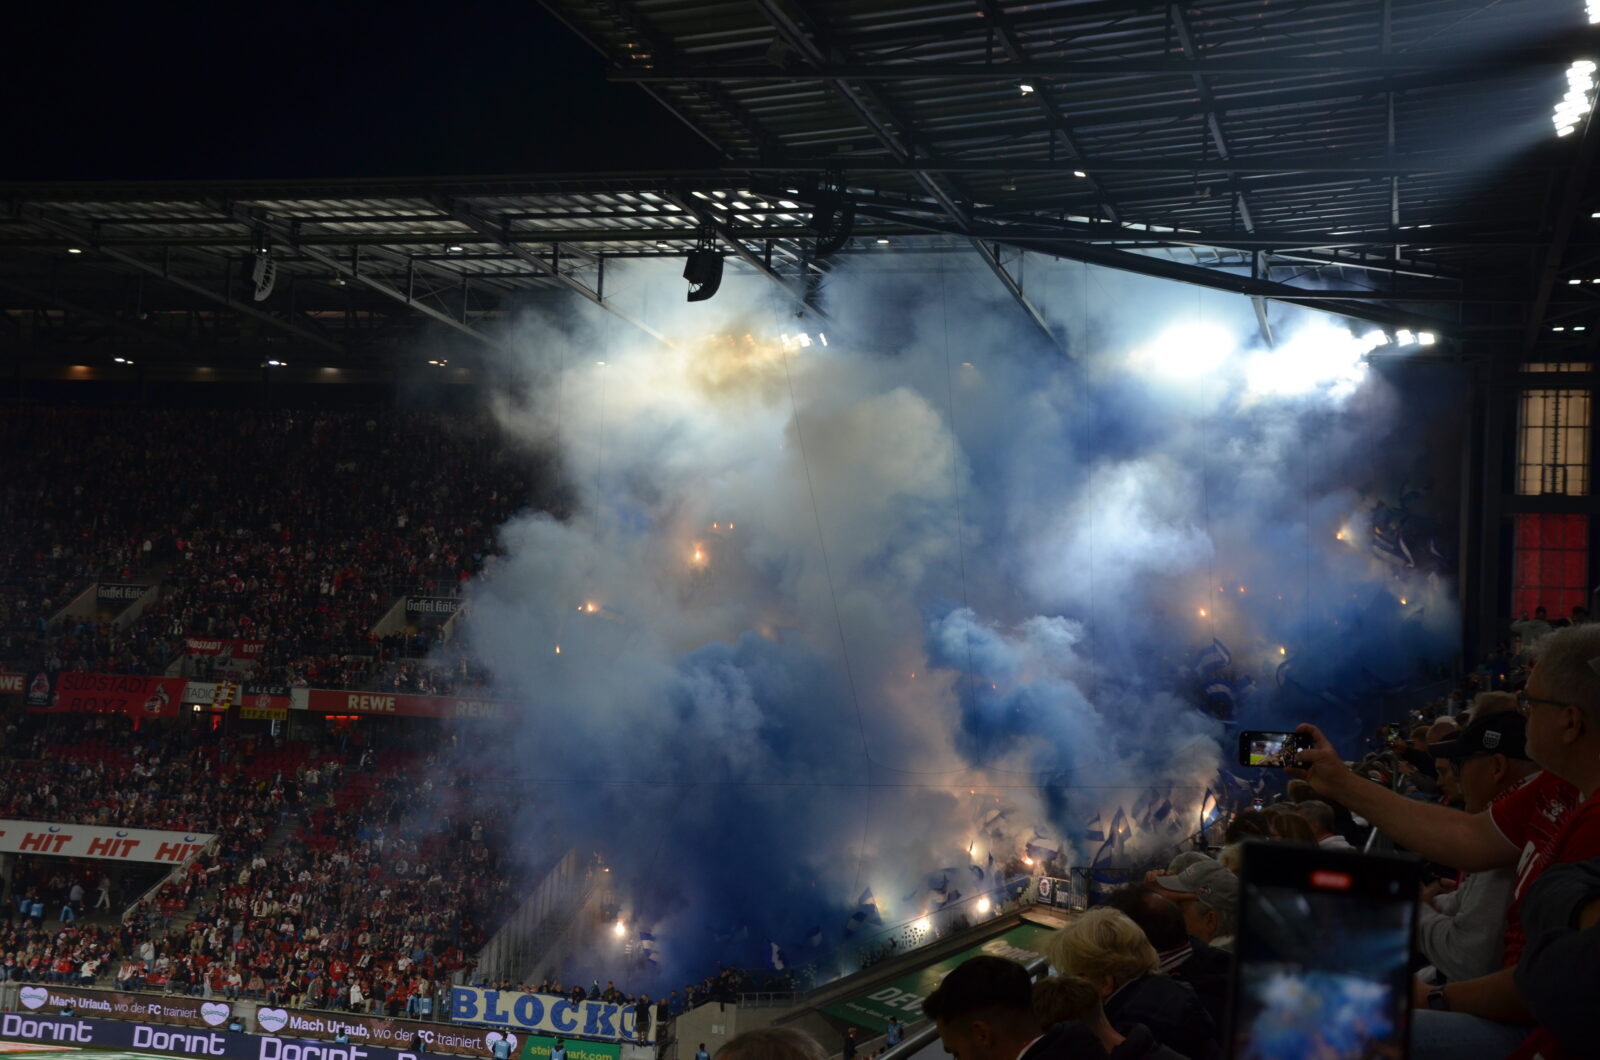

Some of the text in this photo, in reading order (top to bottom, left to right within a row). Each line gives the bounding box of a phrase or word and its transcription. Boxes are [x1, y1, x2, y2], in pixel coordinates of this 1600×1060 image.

[435, 600, 456, 613] Köls
[247, 686, 285, 694] ALLEZ
[348, 694, 396, 713] REWE
[19, 832, 72, 853] HIT
[86, 837, 140, 858] HIT
[49, 995, 76, 1007] Mach
[78, 997, 112, 1012] Urlaub,
[114, 1003, 129, 1011] wo
[130, 1002, 146, 1014] der
[148, 1003, 161, 1015] FC
[163, 1005, 199, 1019] trainiert.
[2, 1014, 93, 1043] Dorint
[290, 1016, 324, 1032] Mach
[373, 1029, 391, 1039] wo
[394, 1028, 414, 1041] der
[437, 1032, 483, 1050] trainiert.
[133, 1025, 226, 1056] Dorint
